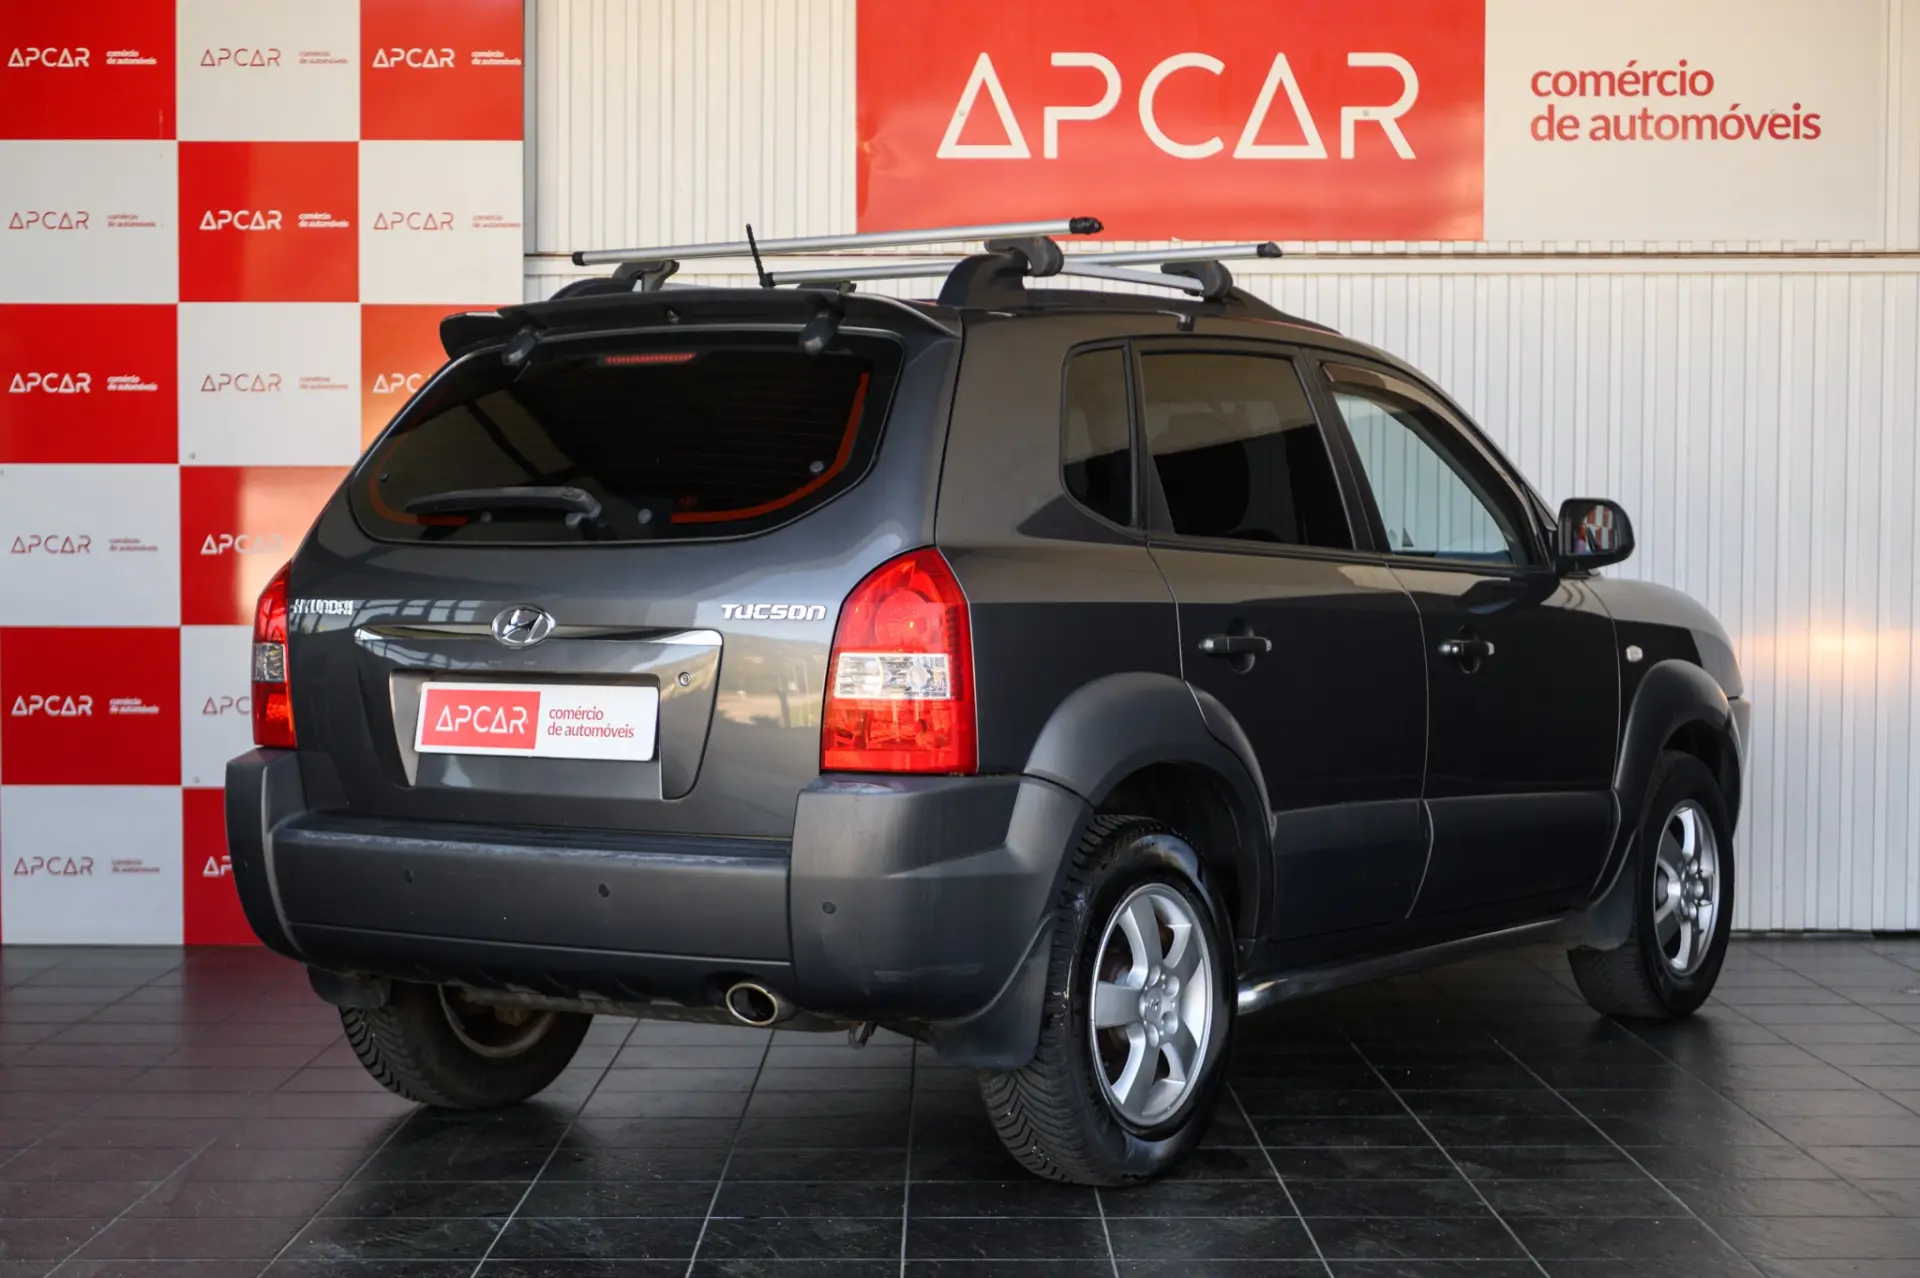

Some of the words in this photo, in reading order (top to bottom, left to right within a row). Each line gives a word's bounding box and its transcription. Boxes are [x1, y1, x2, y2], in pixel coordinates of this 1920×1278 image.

[8, 48, 90, 67] APCAR
[200, 48, 281, 67] APCAR
[372, 48, 455, 68] APCAR
[1531, 59, 1714, 97] comércio
[936, 51, 1420, 160] APCAR
[1531, 104, 1580, 141] de
[1590, 104, 1822, 142] automóveis
[9, 211, 90, 230] APCAR
[200, 210, 282, 230] APCAR
[373, 212, 454, 230] APCAR
[9, 373, 91, 393] APCAR
[201, 373, 281, 392] APCAR
[373, 373, 432, 394] APC
[11, 535, 91, 554] APCAR
[201, 533, 283, 555] APCAR
[721, 604, 827, 621] TUCSON
[12, 695, 92, 716] APCAR
[549, 705, 604, 721] comércio
[435, 704, 527, 735] APCAR
[547, 722, 563, 736] de
[564, 722, 634, 739] automóveis
[14, 857, 93, 876] APCAR
